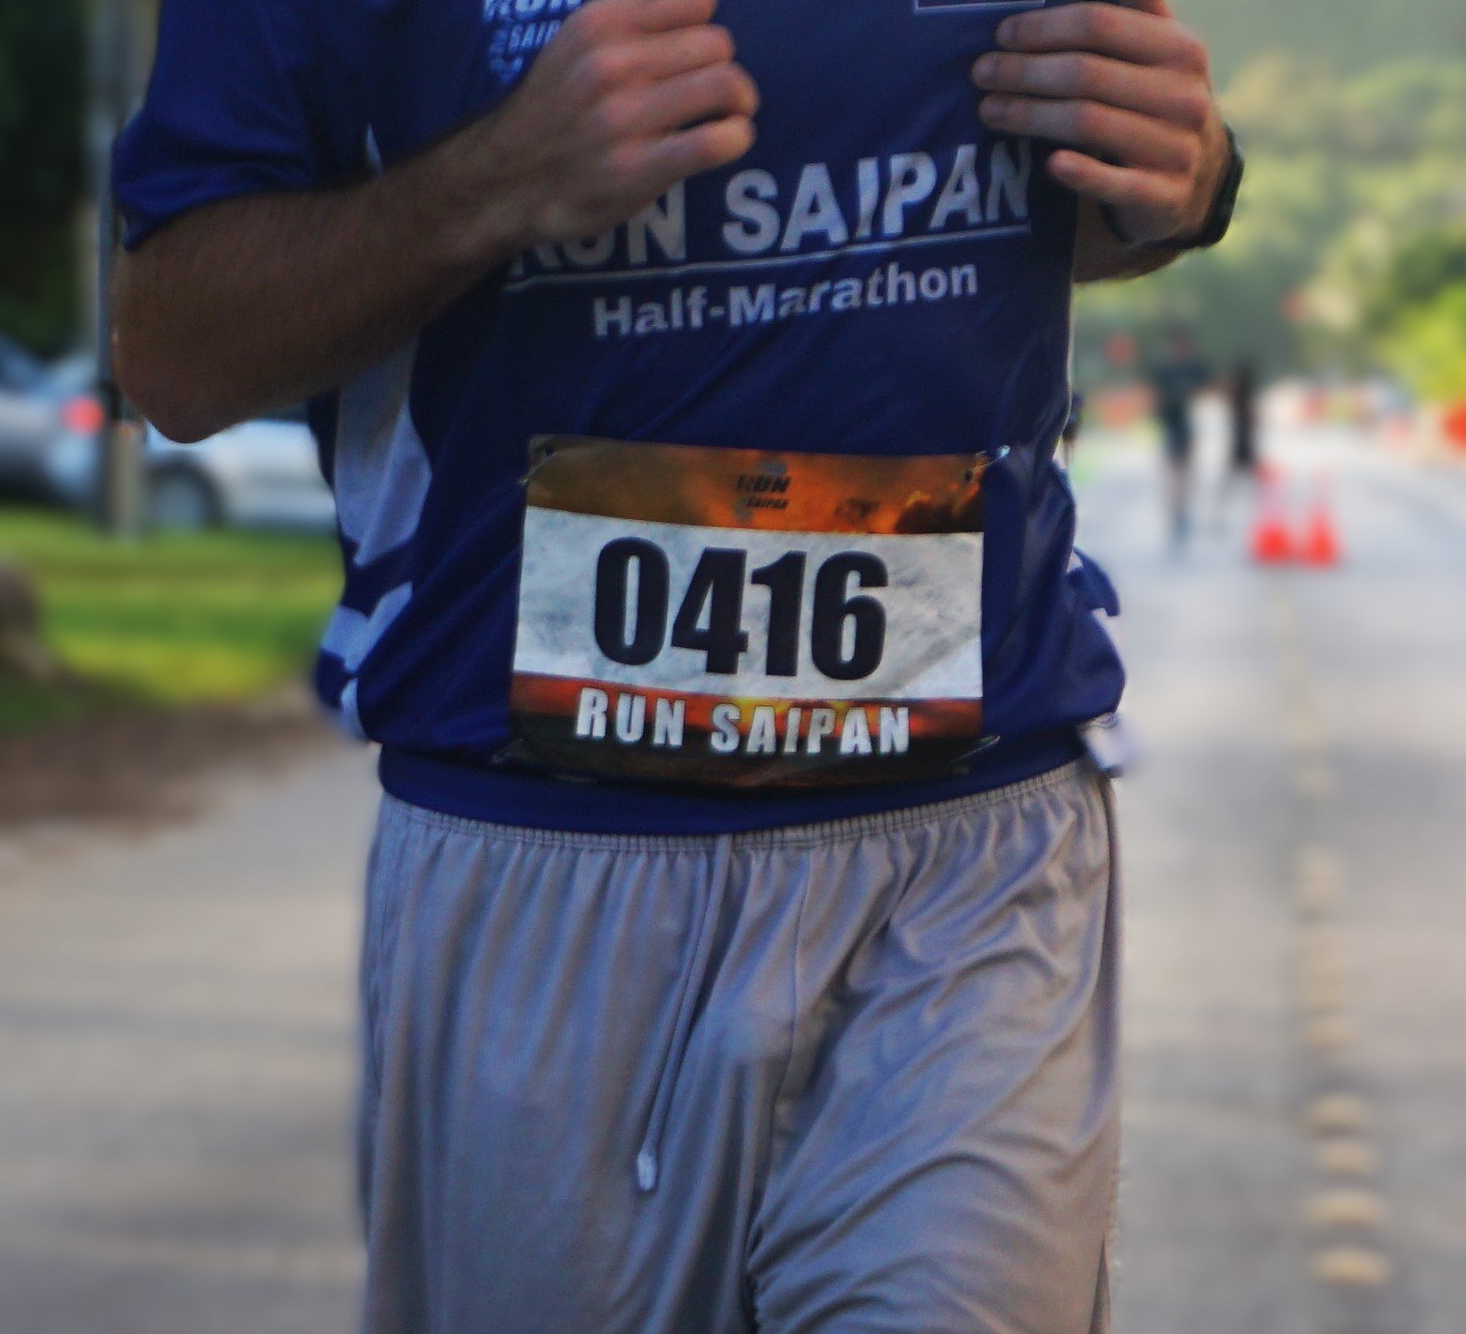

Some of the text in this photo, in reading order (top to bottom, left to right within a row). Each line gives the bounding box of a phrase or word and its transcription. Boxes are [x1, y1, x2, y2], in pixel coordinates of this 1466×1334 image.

[723, 140, 1031, 253] SAIPAN
[593, 264, 977, 337] Half-Marathon
[594, 537, 889, 681] 0416
[577, 687, 910, 756] RUN SAIPAN
